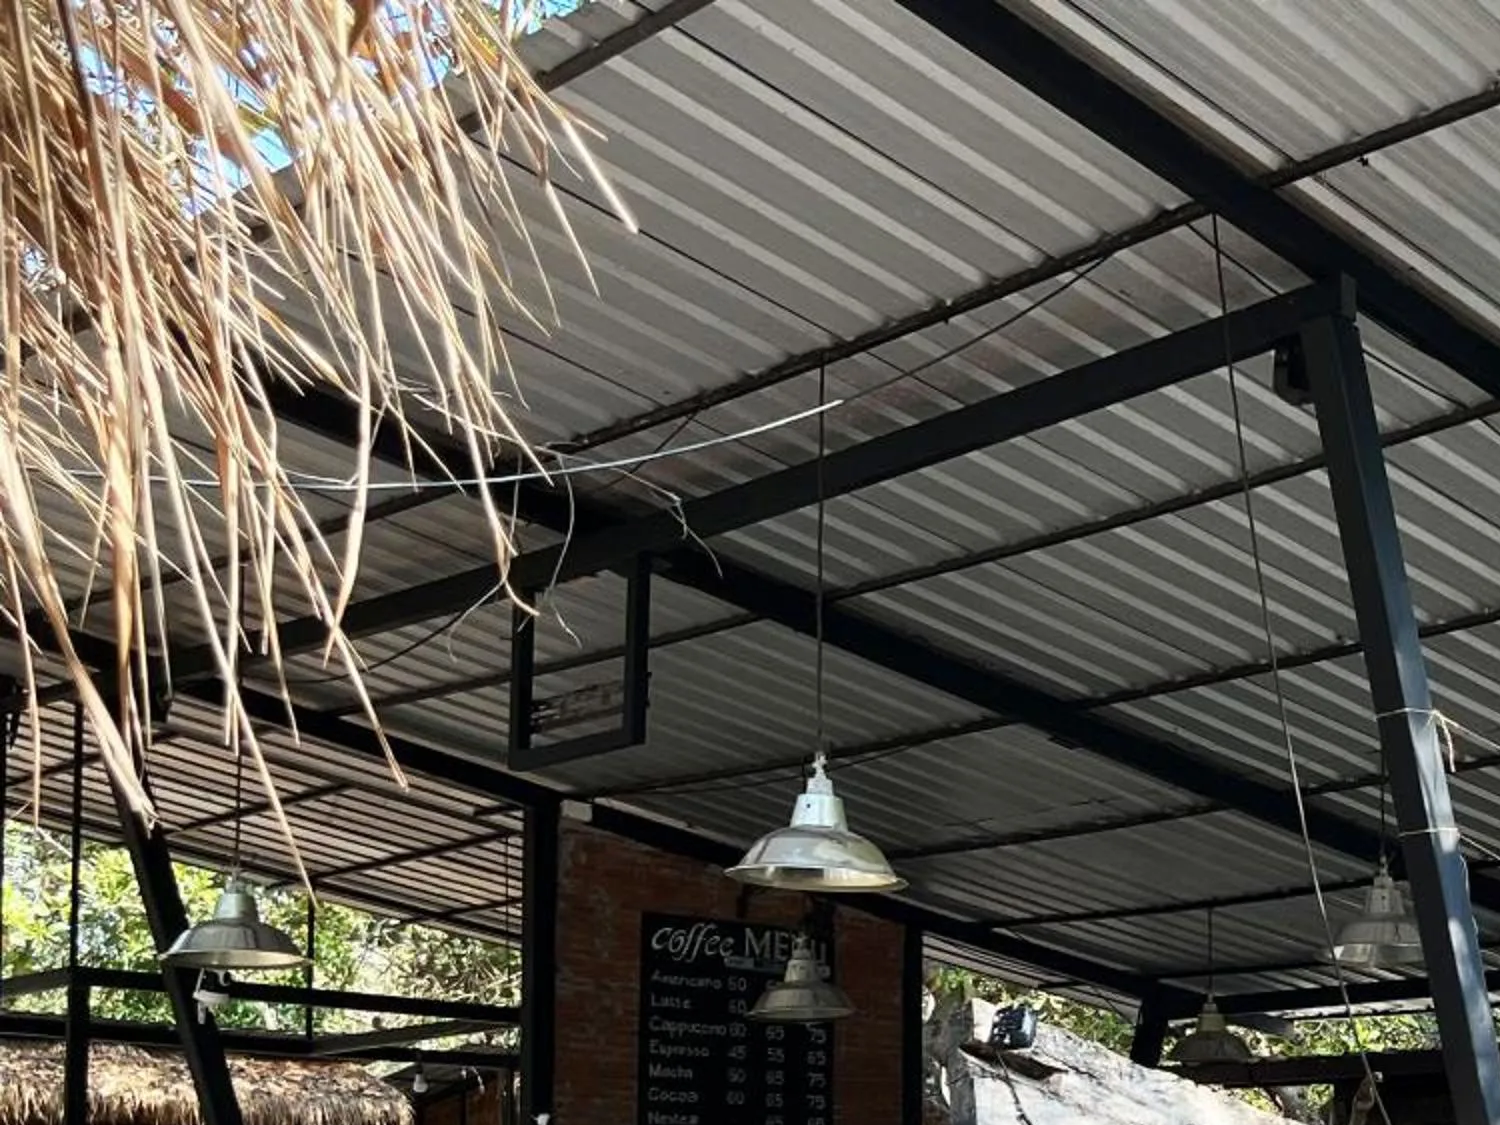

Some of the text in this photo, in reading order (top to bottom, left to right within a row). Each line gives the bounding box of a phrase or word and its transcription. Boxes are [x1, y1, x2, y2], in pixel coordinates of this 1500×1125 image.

[648, 1038, 710, 1058] Espresso
[727, 1045, 748, 1060] 45
[806, 1072, 827, 1088] 75
[647, 1087, 699, 1104] Cocoa
[805, 1094, 826, 1110] 75
